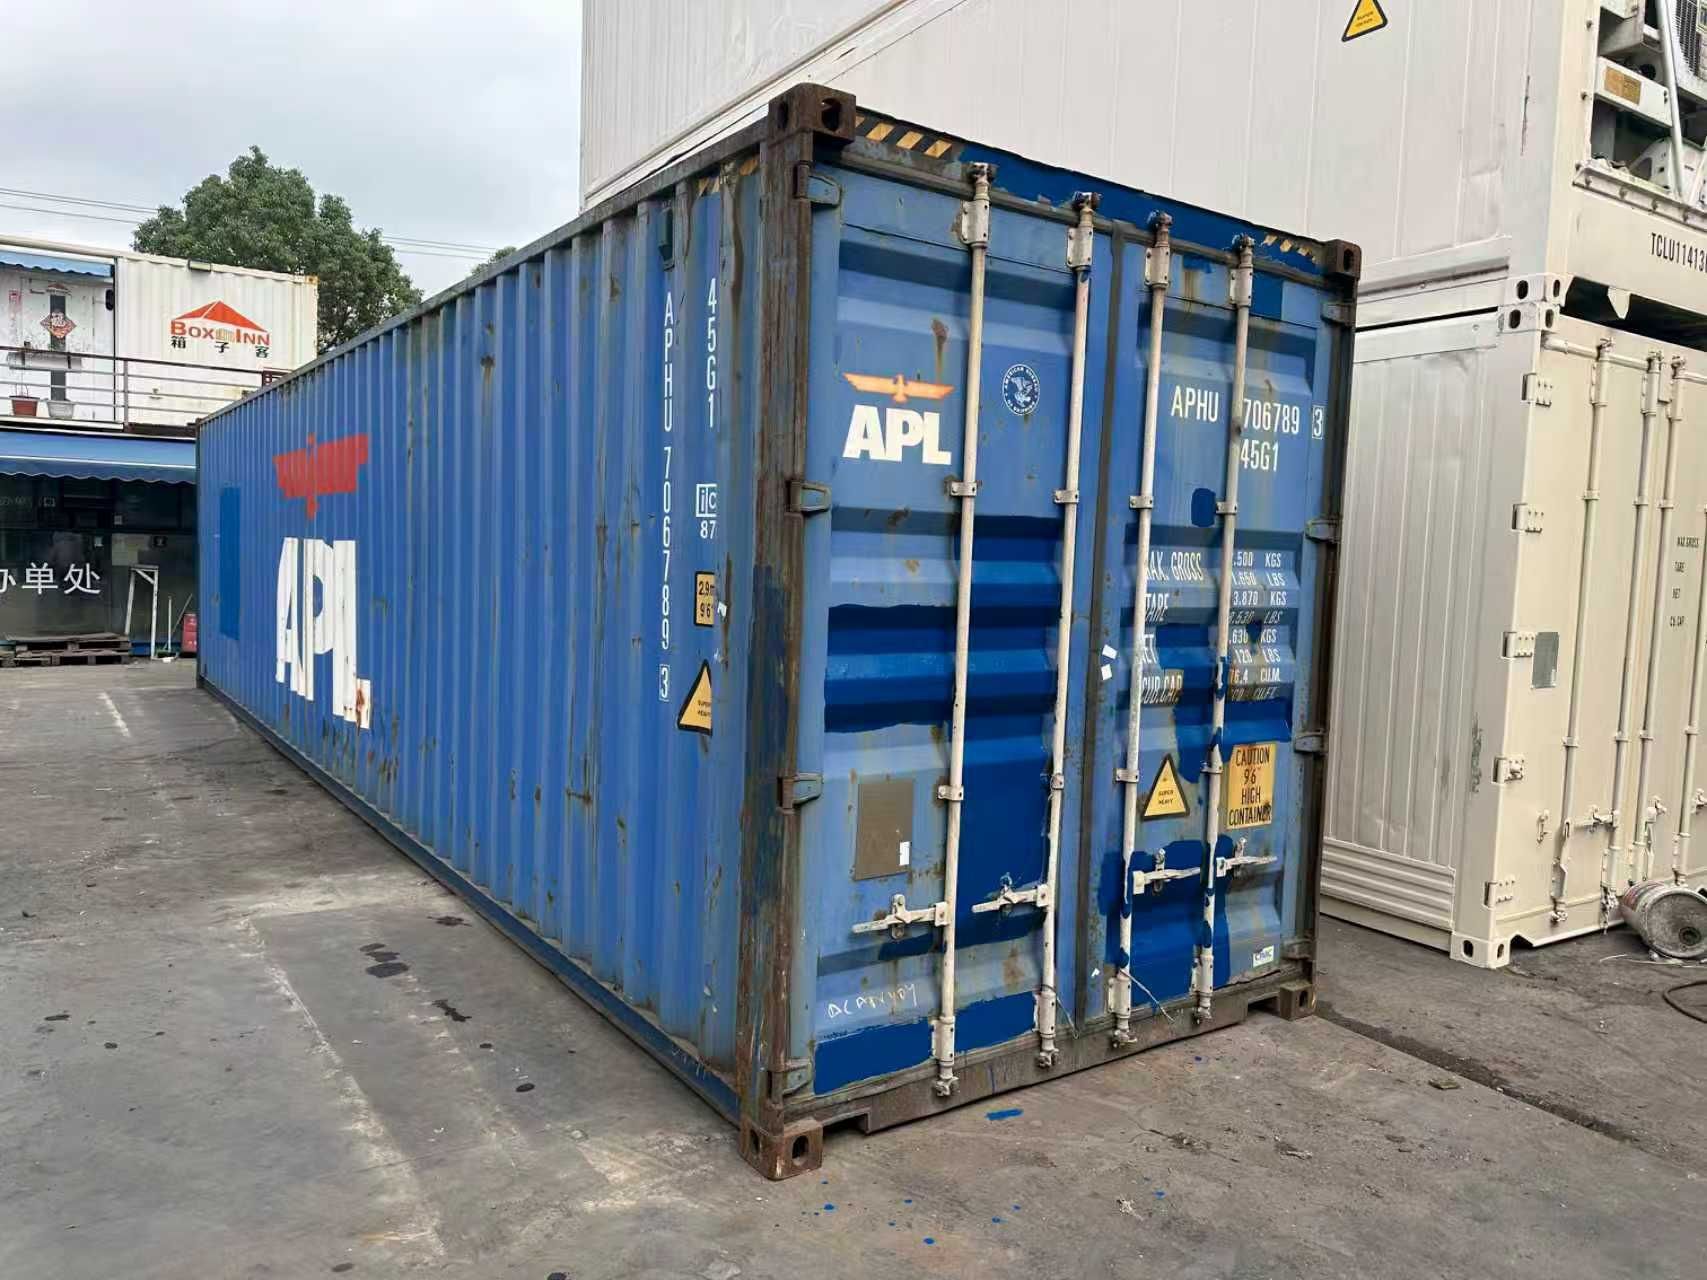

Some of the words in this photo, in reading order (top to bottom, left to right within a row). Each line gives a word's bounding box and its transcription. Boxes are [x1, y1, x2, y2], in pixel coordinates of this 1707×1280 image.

[664, 291, 674, 432] APHU
[706, 277, 717, 428] 45G1
[1171, 385, 1219, 422] APHU
[1243, 398, 1300, 434] 706789
[1312, 405, 1325, 438] 3
[842, 404, 952, 465] APL
[1240, 438, 1279, 472] 45G1
[700, 520, 717, 539] 87
[662, 446, 672, 650] 706789
[1265, 552, 1281, 568] KGS
[1147, 551, 1169, 581] AX.
[1171, 551, 1204, 581] GROSS
[1270, 591, 1287, 606] KGS
[275, 537, 370, 729] APL
[1235, 746, 1270, 767] CAUTION
[1241, 787, 1261, 805] HIGH
